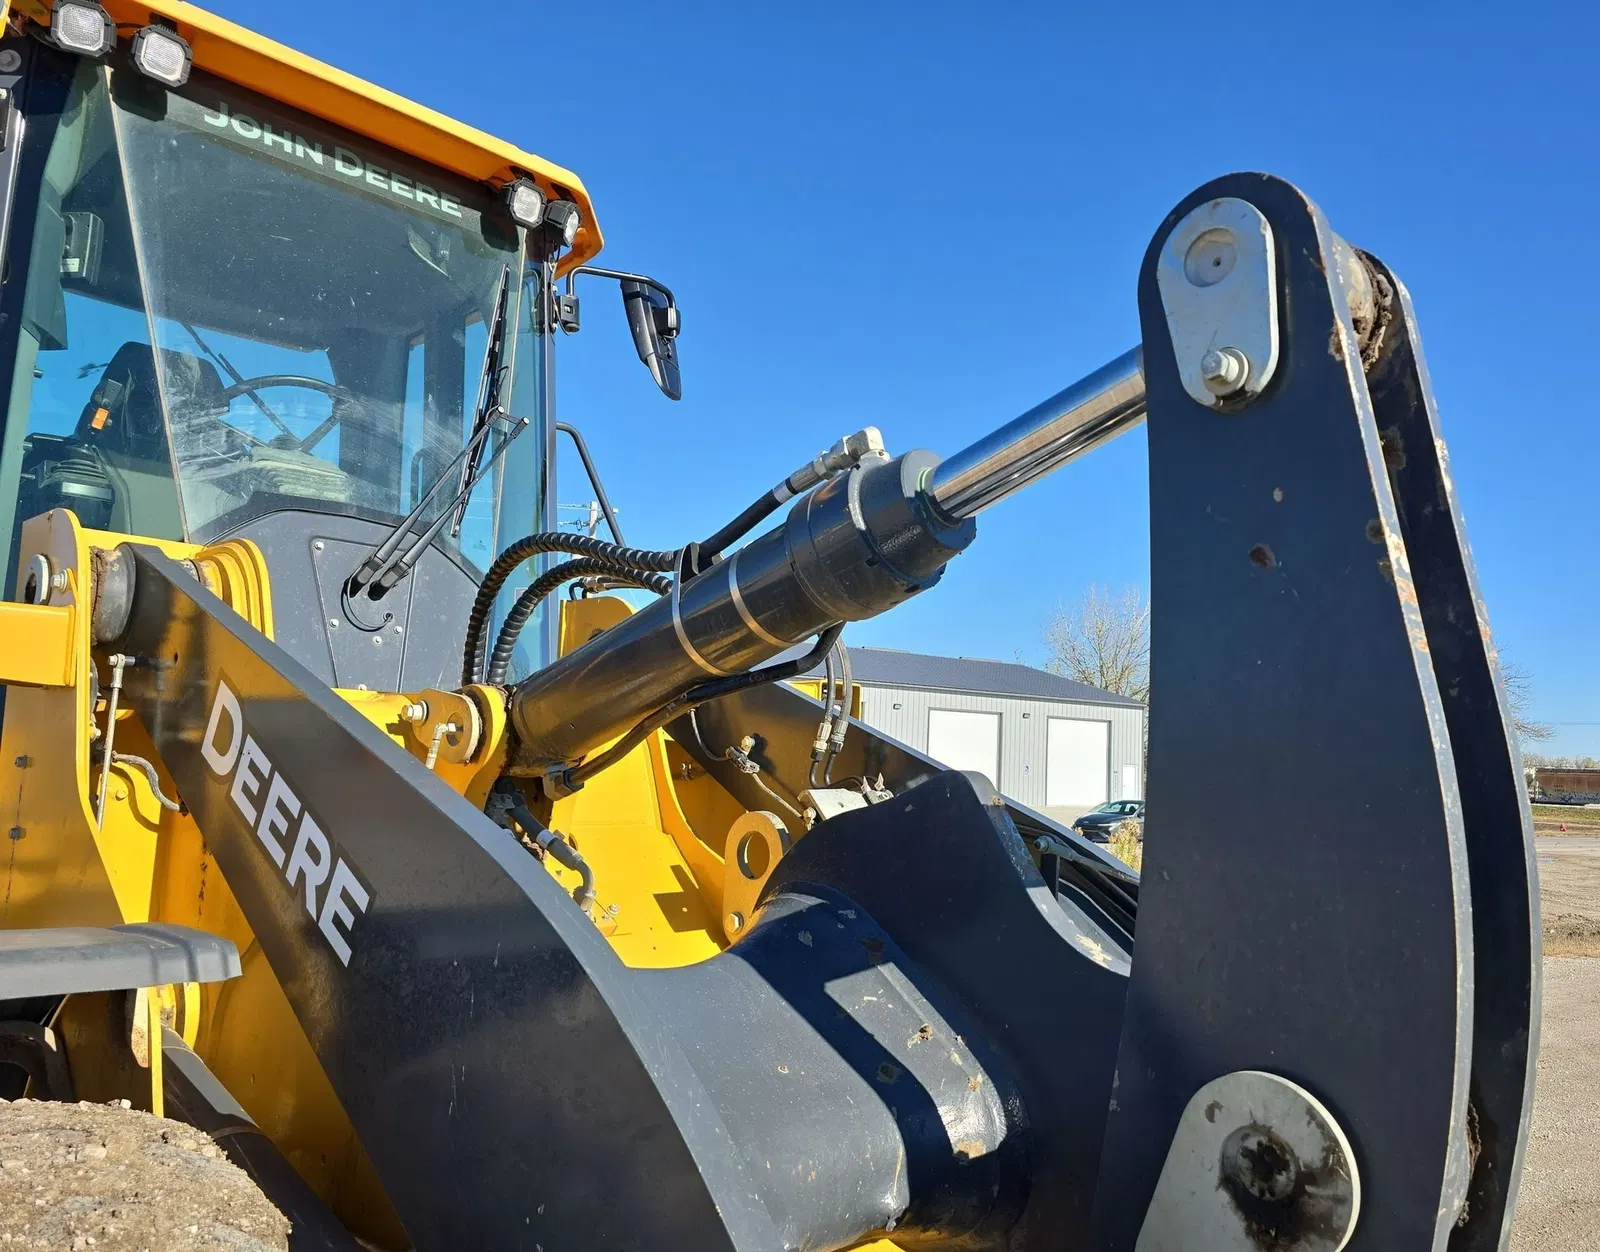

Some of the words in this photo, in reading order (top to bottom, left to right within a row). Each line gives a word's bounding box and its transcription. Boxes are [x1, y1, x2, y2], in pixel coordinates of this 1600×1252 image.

[204, 101, 323, 165] JOHN
[335, 146, 462, 217] DEERE
[201, 679, 370, 967] DEERE
